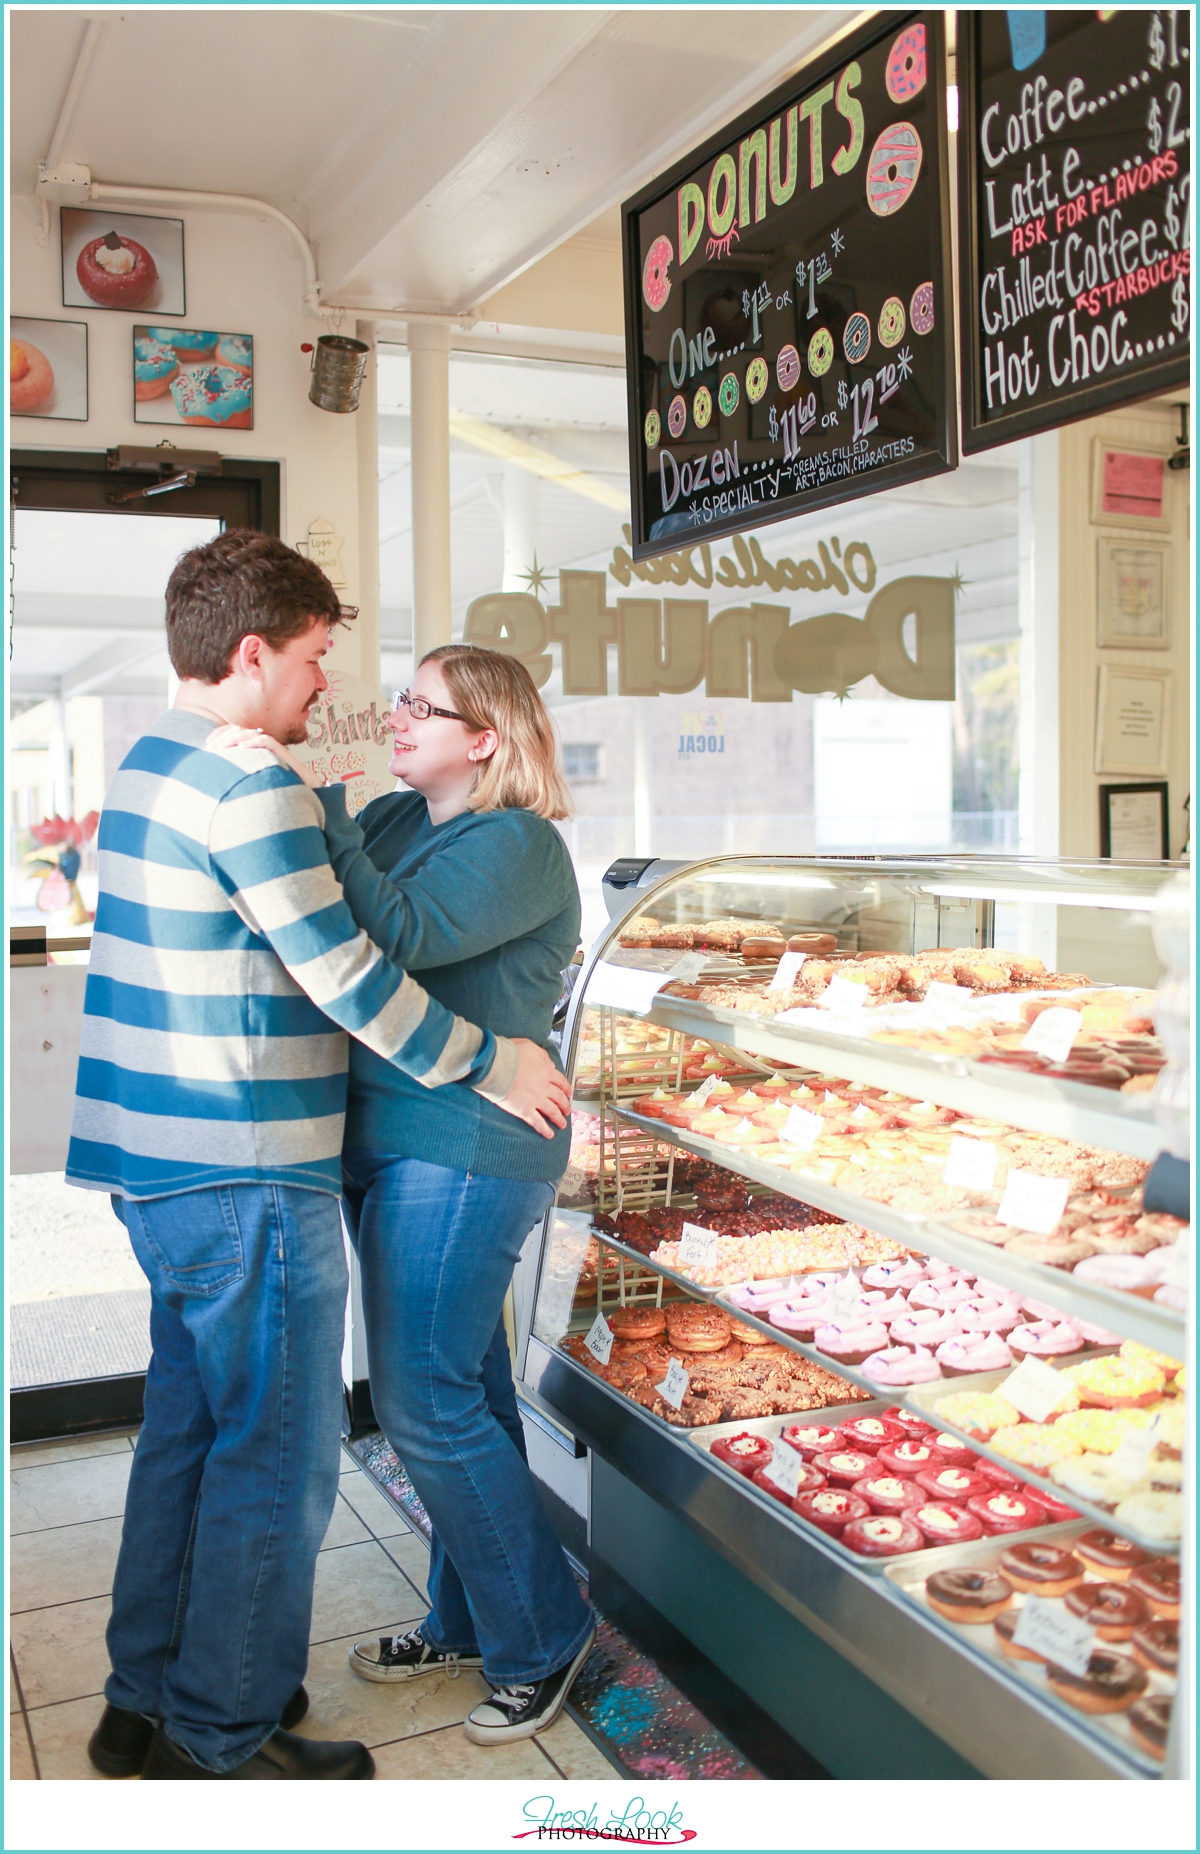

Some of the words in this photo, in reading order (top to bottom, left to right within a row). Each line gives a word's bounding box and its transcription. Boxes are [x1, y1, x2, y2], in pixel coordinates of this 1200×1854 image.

[1012, 217, 1048, 256] ASK
[1056, 196, 1088, 233] FOR
[1091, 150, 1178, 214] FLAVORS
[776, 291, 793, 310] OR
[984, 335, 1040, 409] Hot
[821, 411, 838, 428] OR
